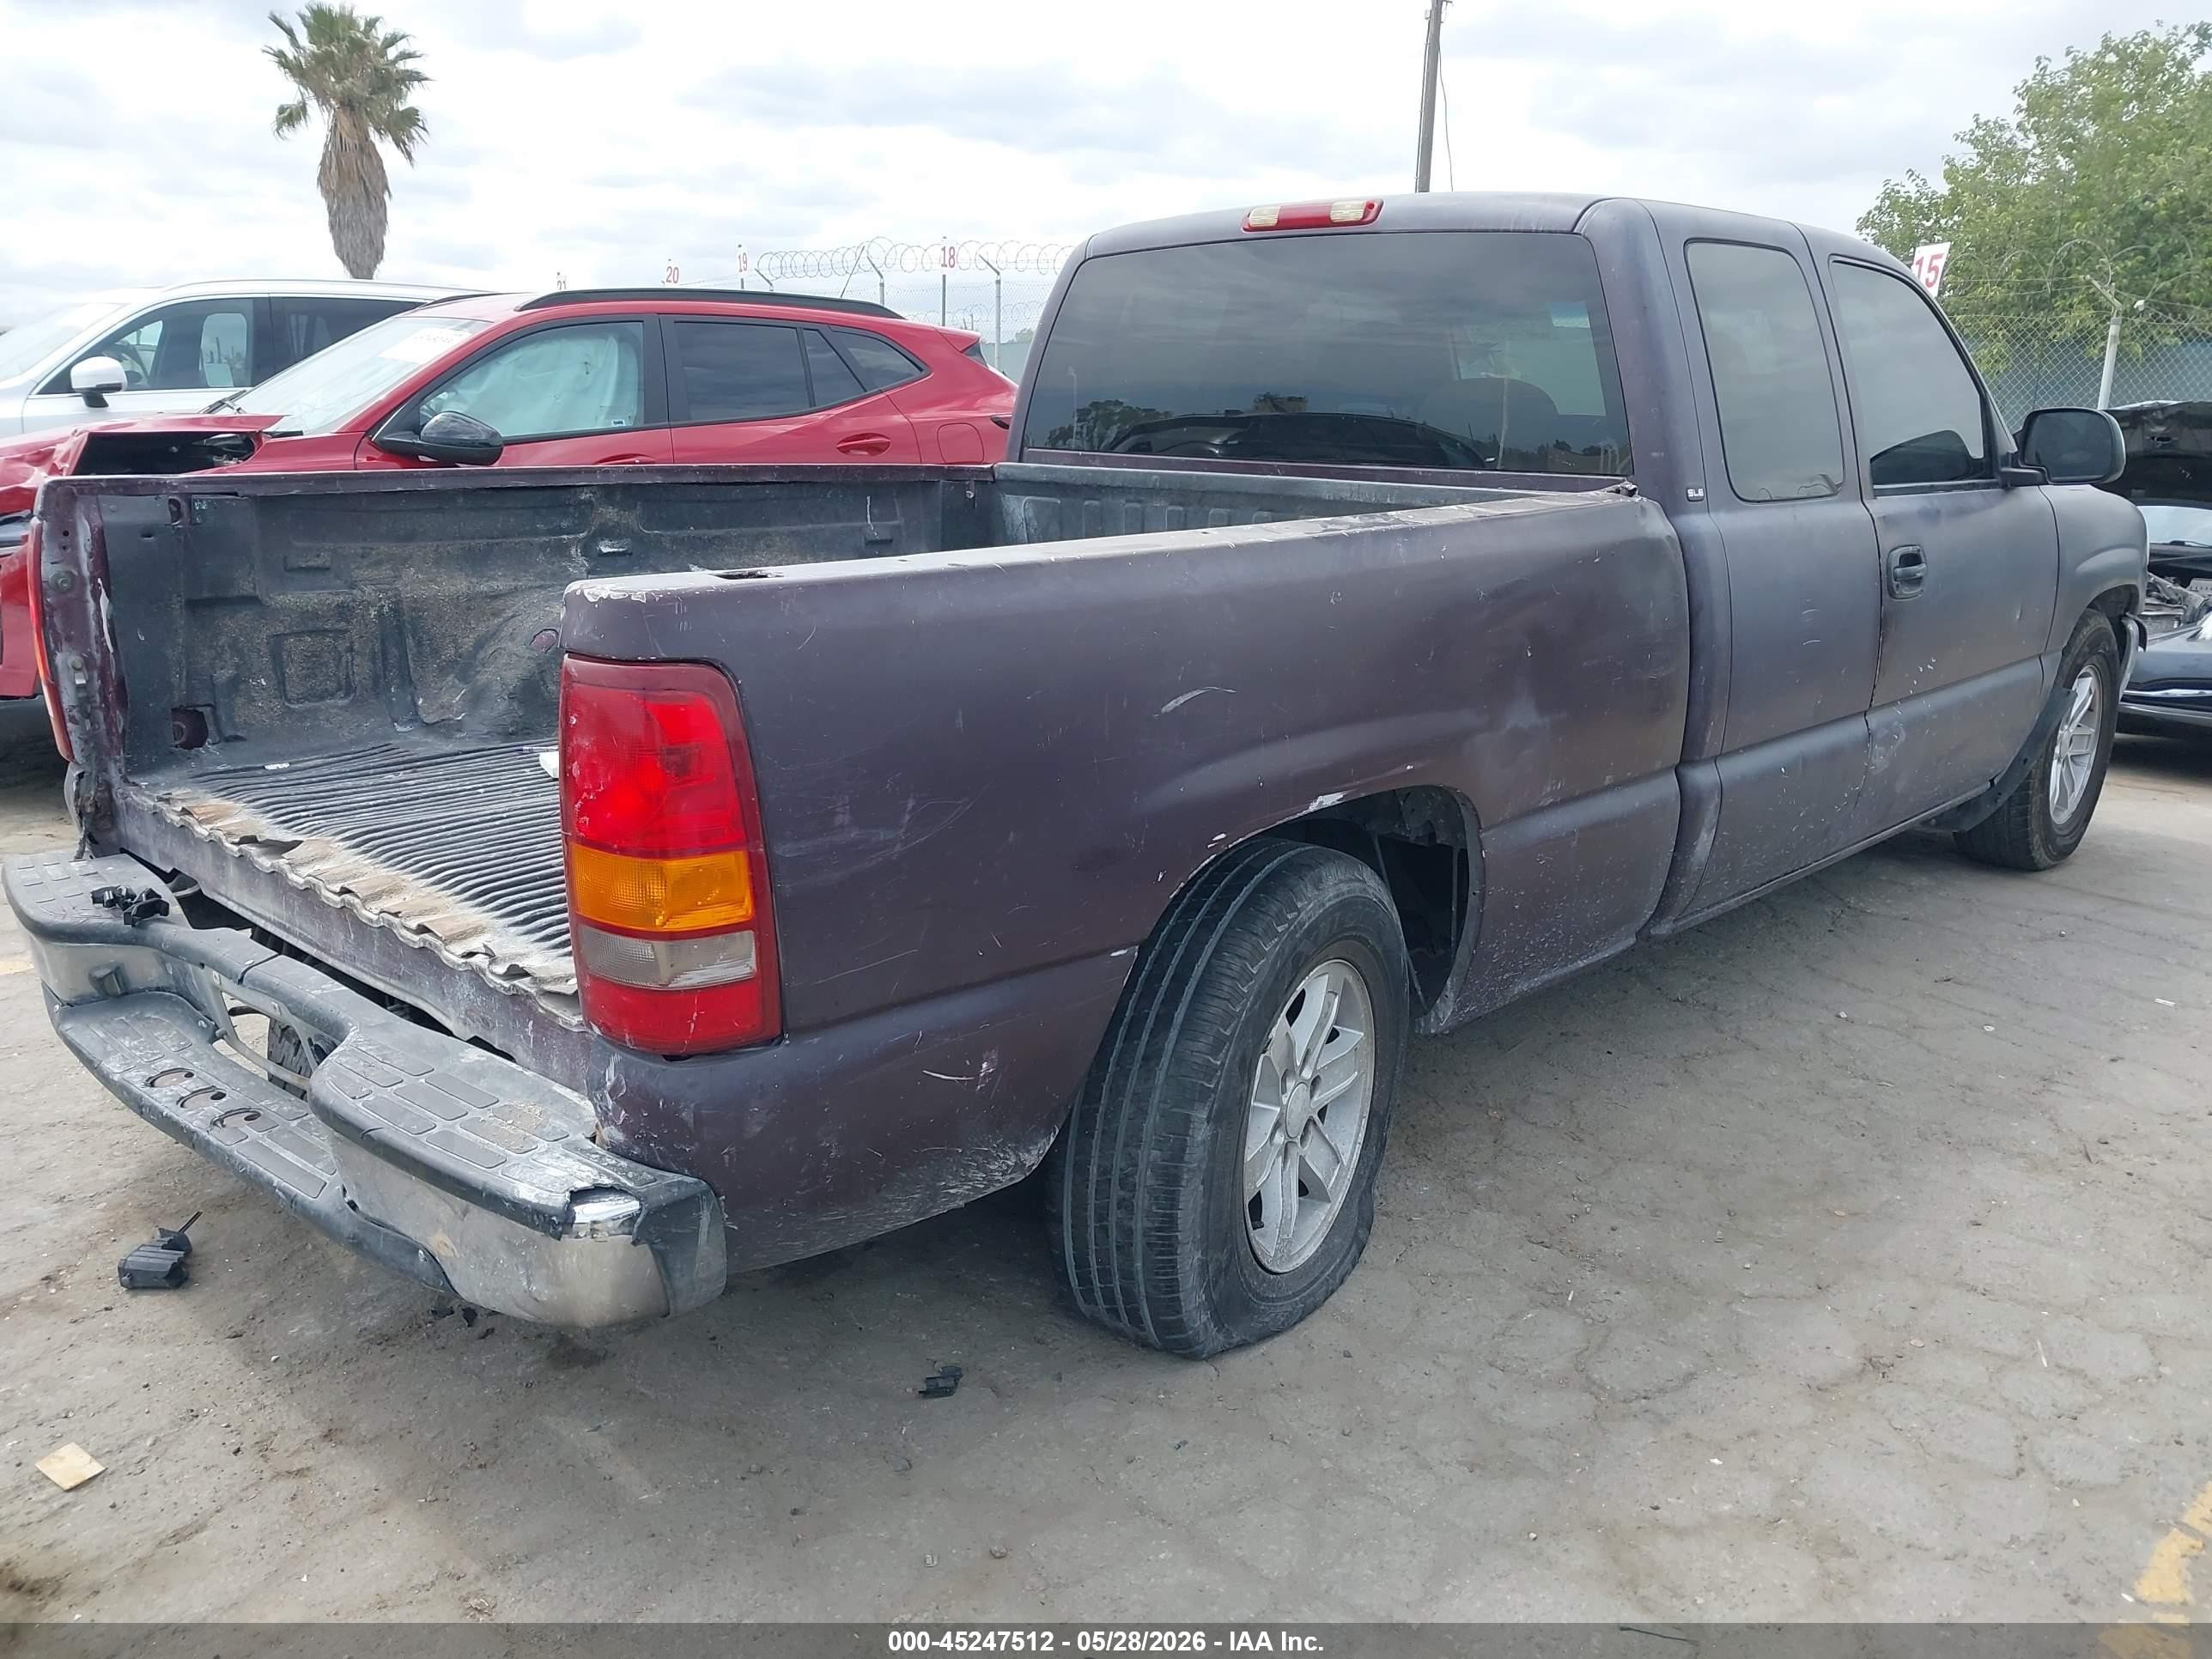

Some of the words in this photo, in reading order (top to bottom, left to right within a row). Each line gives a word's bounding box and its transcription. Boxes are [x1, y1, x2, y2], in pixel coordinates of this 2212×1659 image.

[738, 252, 748, 272] 19
[940, 246, 956, 269] 18
[665, 265, 680, 284] 20
[1915, 252, 1944, 289] 15
